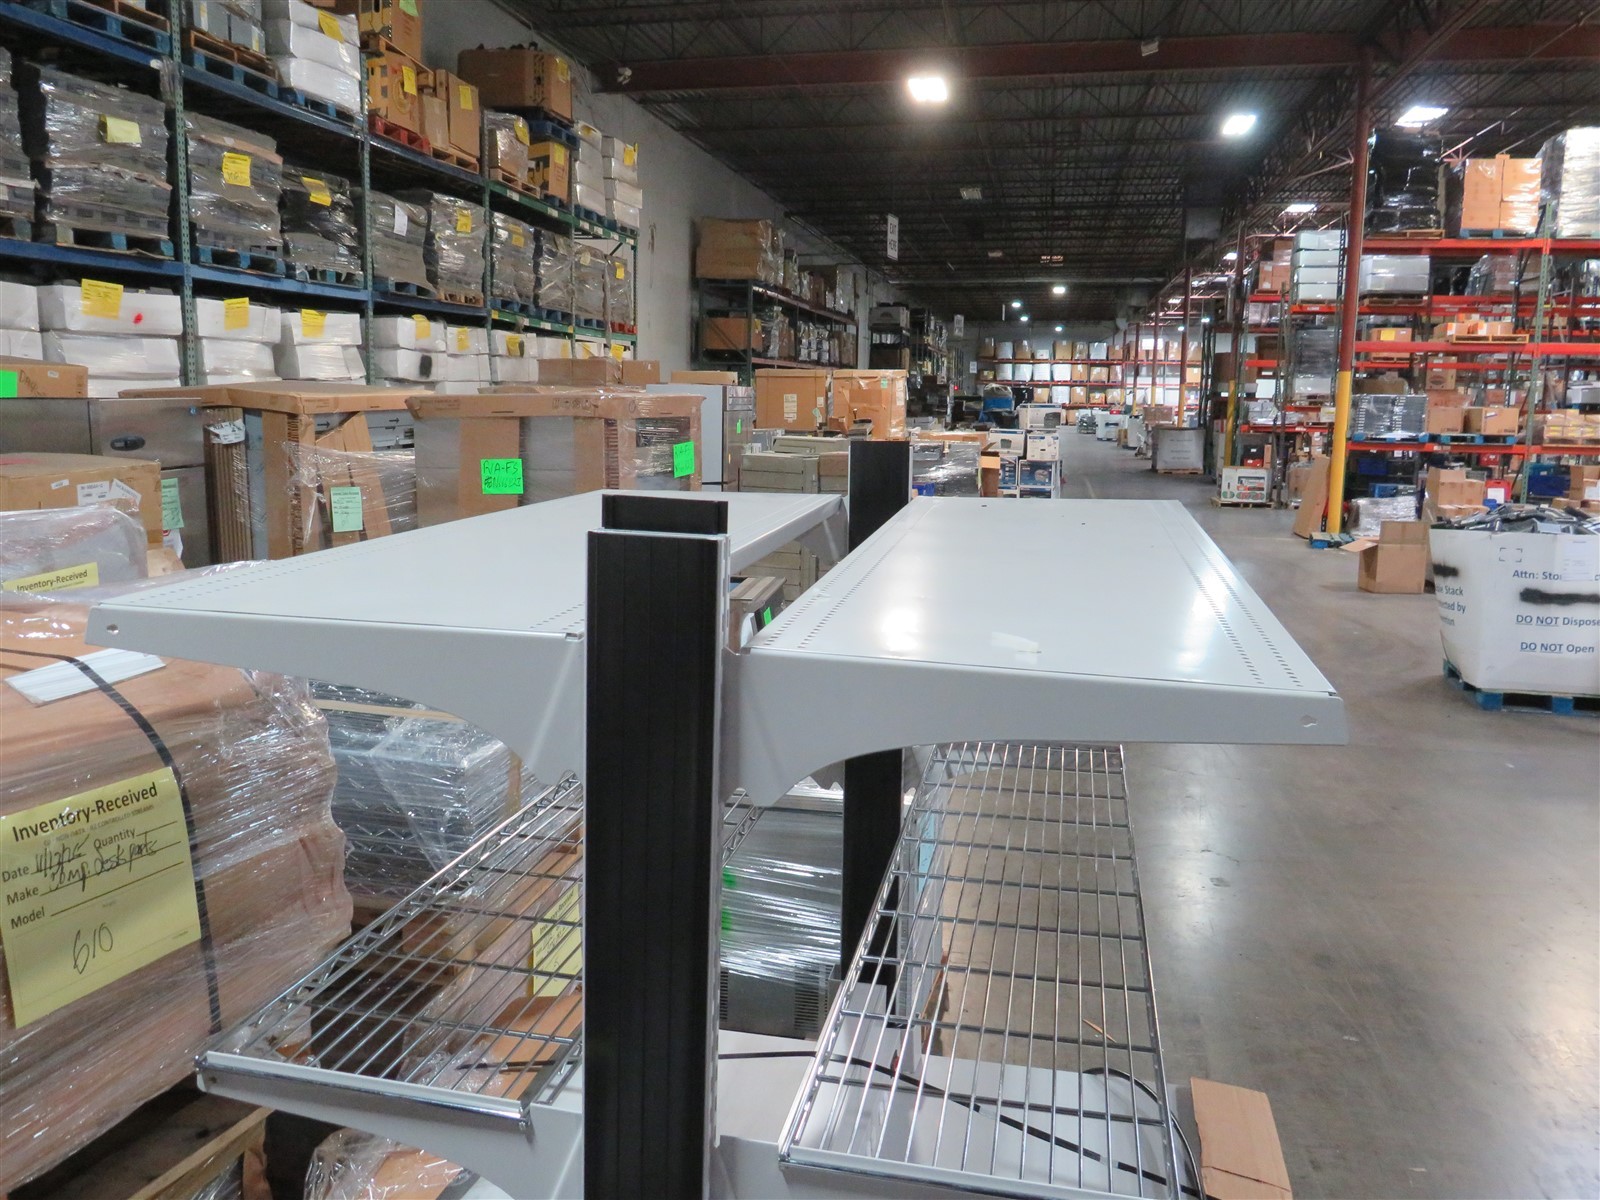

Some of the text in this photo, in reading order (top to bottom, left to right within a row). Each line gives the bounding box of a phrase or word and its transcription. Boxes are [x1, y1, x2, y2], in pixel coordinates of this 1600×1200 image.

[17, 569, 88, 592] Inventory-Received
[1512, 569, 1562, 581] Attn: Sto
[1444, 585, 1464, 596] Stack
[1457, 602, 1466, 614] by
[1515, 614, 1533, 625] DO
[1536, 616, 1560, 626] NOT
[1520, 641, 1595, 654] DO NOT Open
[12, 781, 158, 842] Inventory-Received
[2, 866, 30, 883] Date
[93, 828, 136, 850] Quantity
[6, 887, 39, 905] Make
[11, 906, 45, 929] Model
[72, 922, 114, 975] 610
